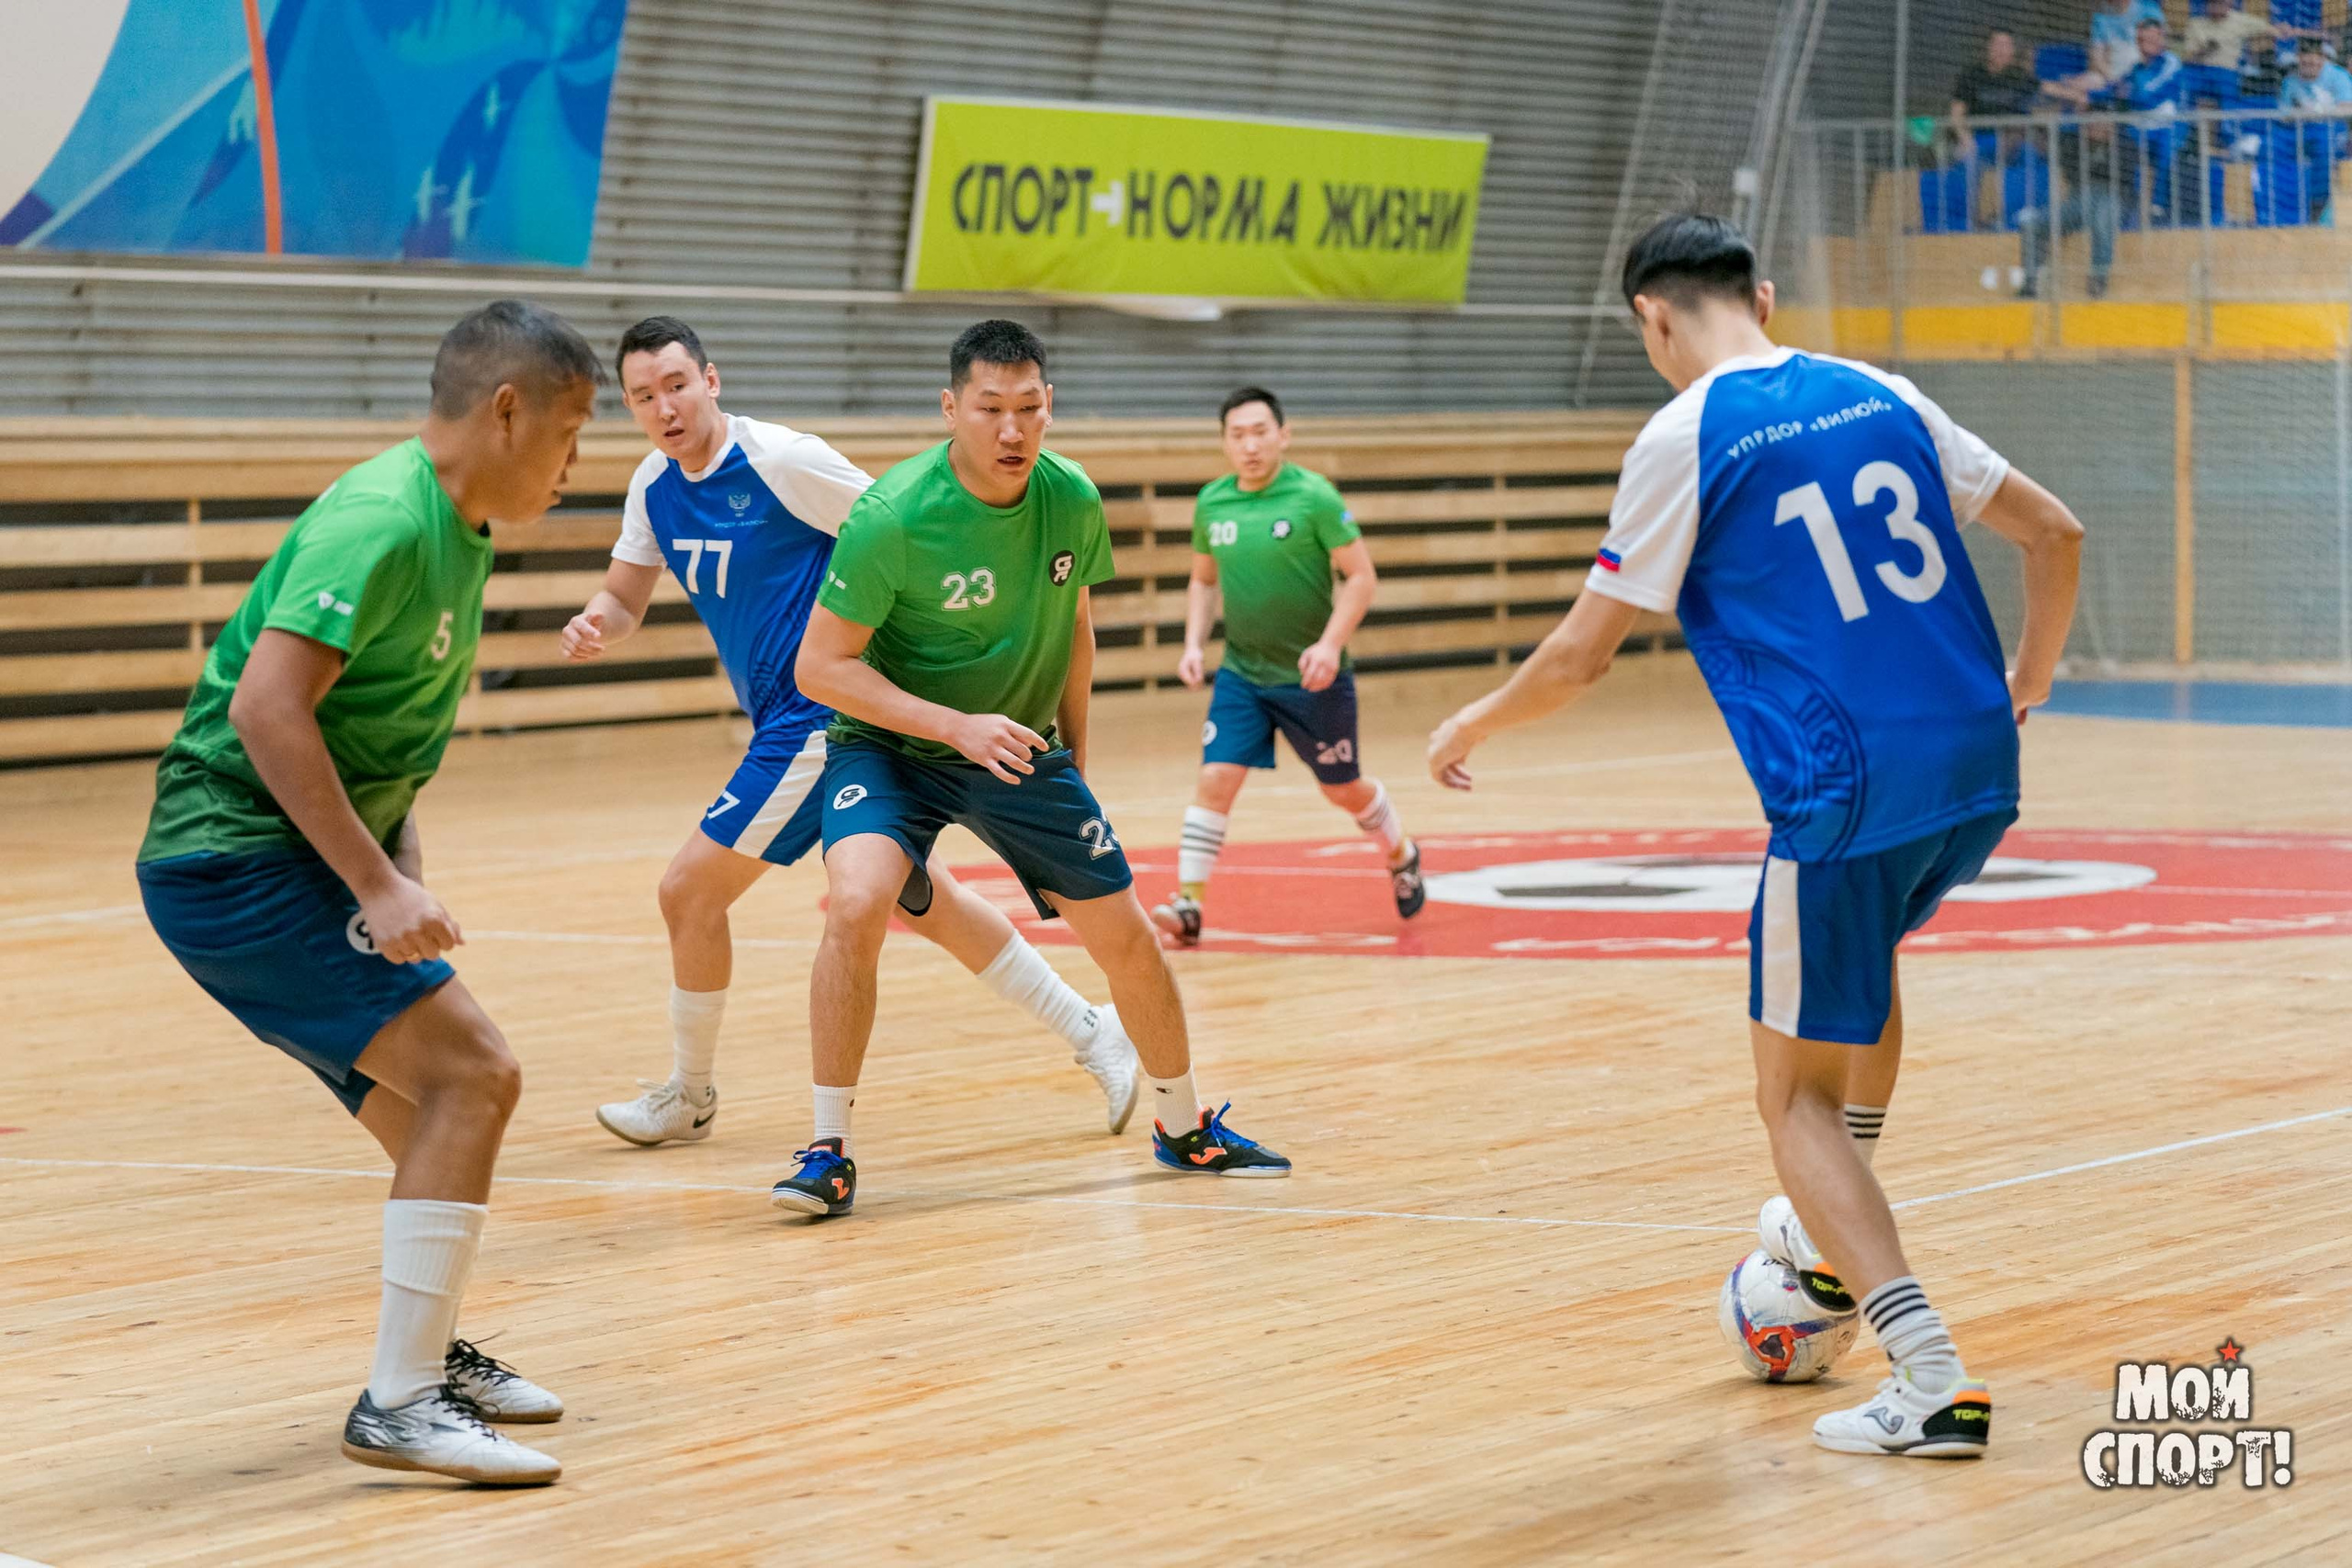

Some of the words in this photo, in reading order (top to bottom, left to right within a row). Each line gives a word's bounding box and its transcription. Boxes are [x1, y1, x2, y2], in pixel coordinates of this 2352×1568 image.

[953, 164, 1094, 235] СПОРТ
[1126, 169, 1300, 244] НОРМА
[1317, 180, 1469, 252] ЖИЗНИ
[1727, 420, 1804, 459] УПРДОР
[1208, 520, 1238, 547] 20
[1773, 460, 1947, 623] 13
[672, 538, 732, 599] 77
[940, 566, 997, 612] 23
[430, 609, 453, 661] 5
